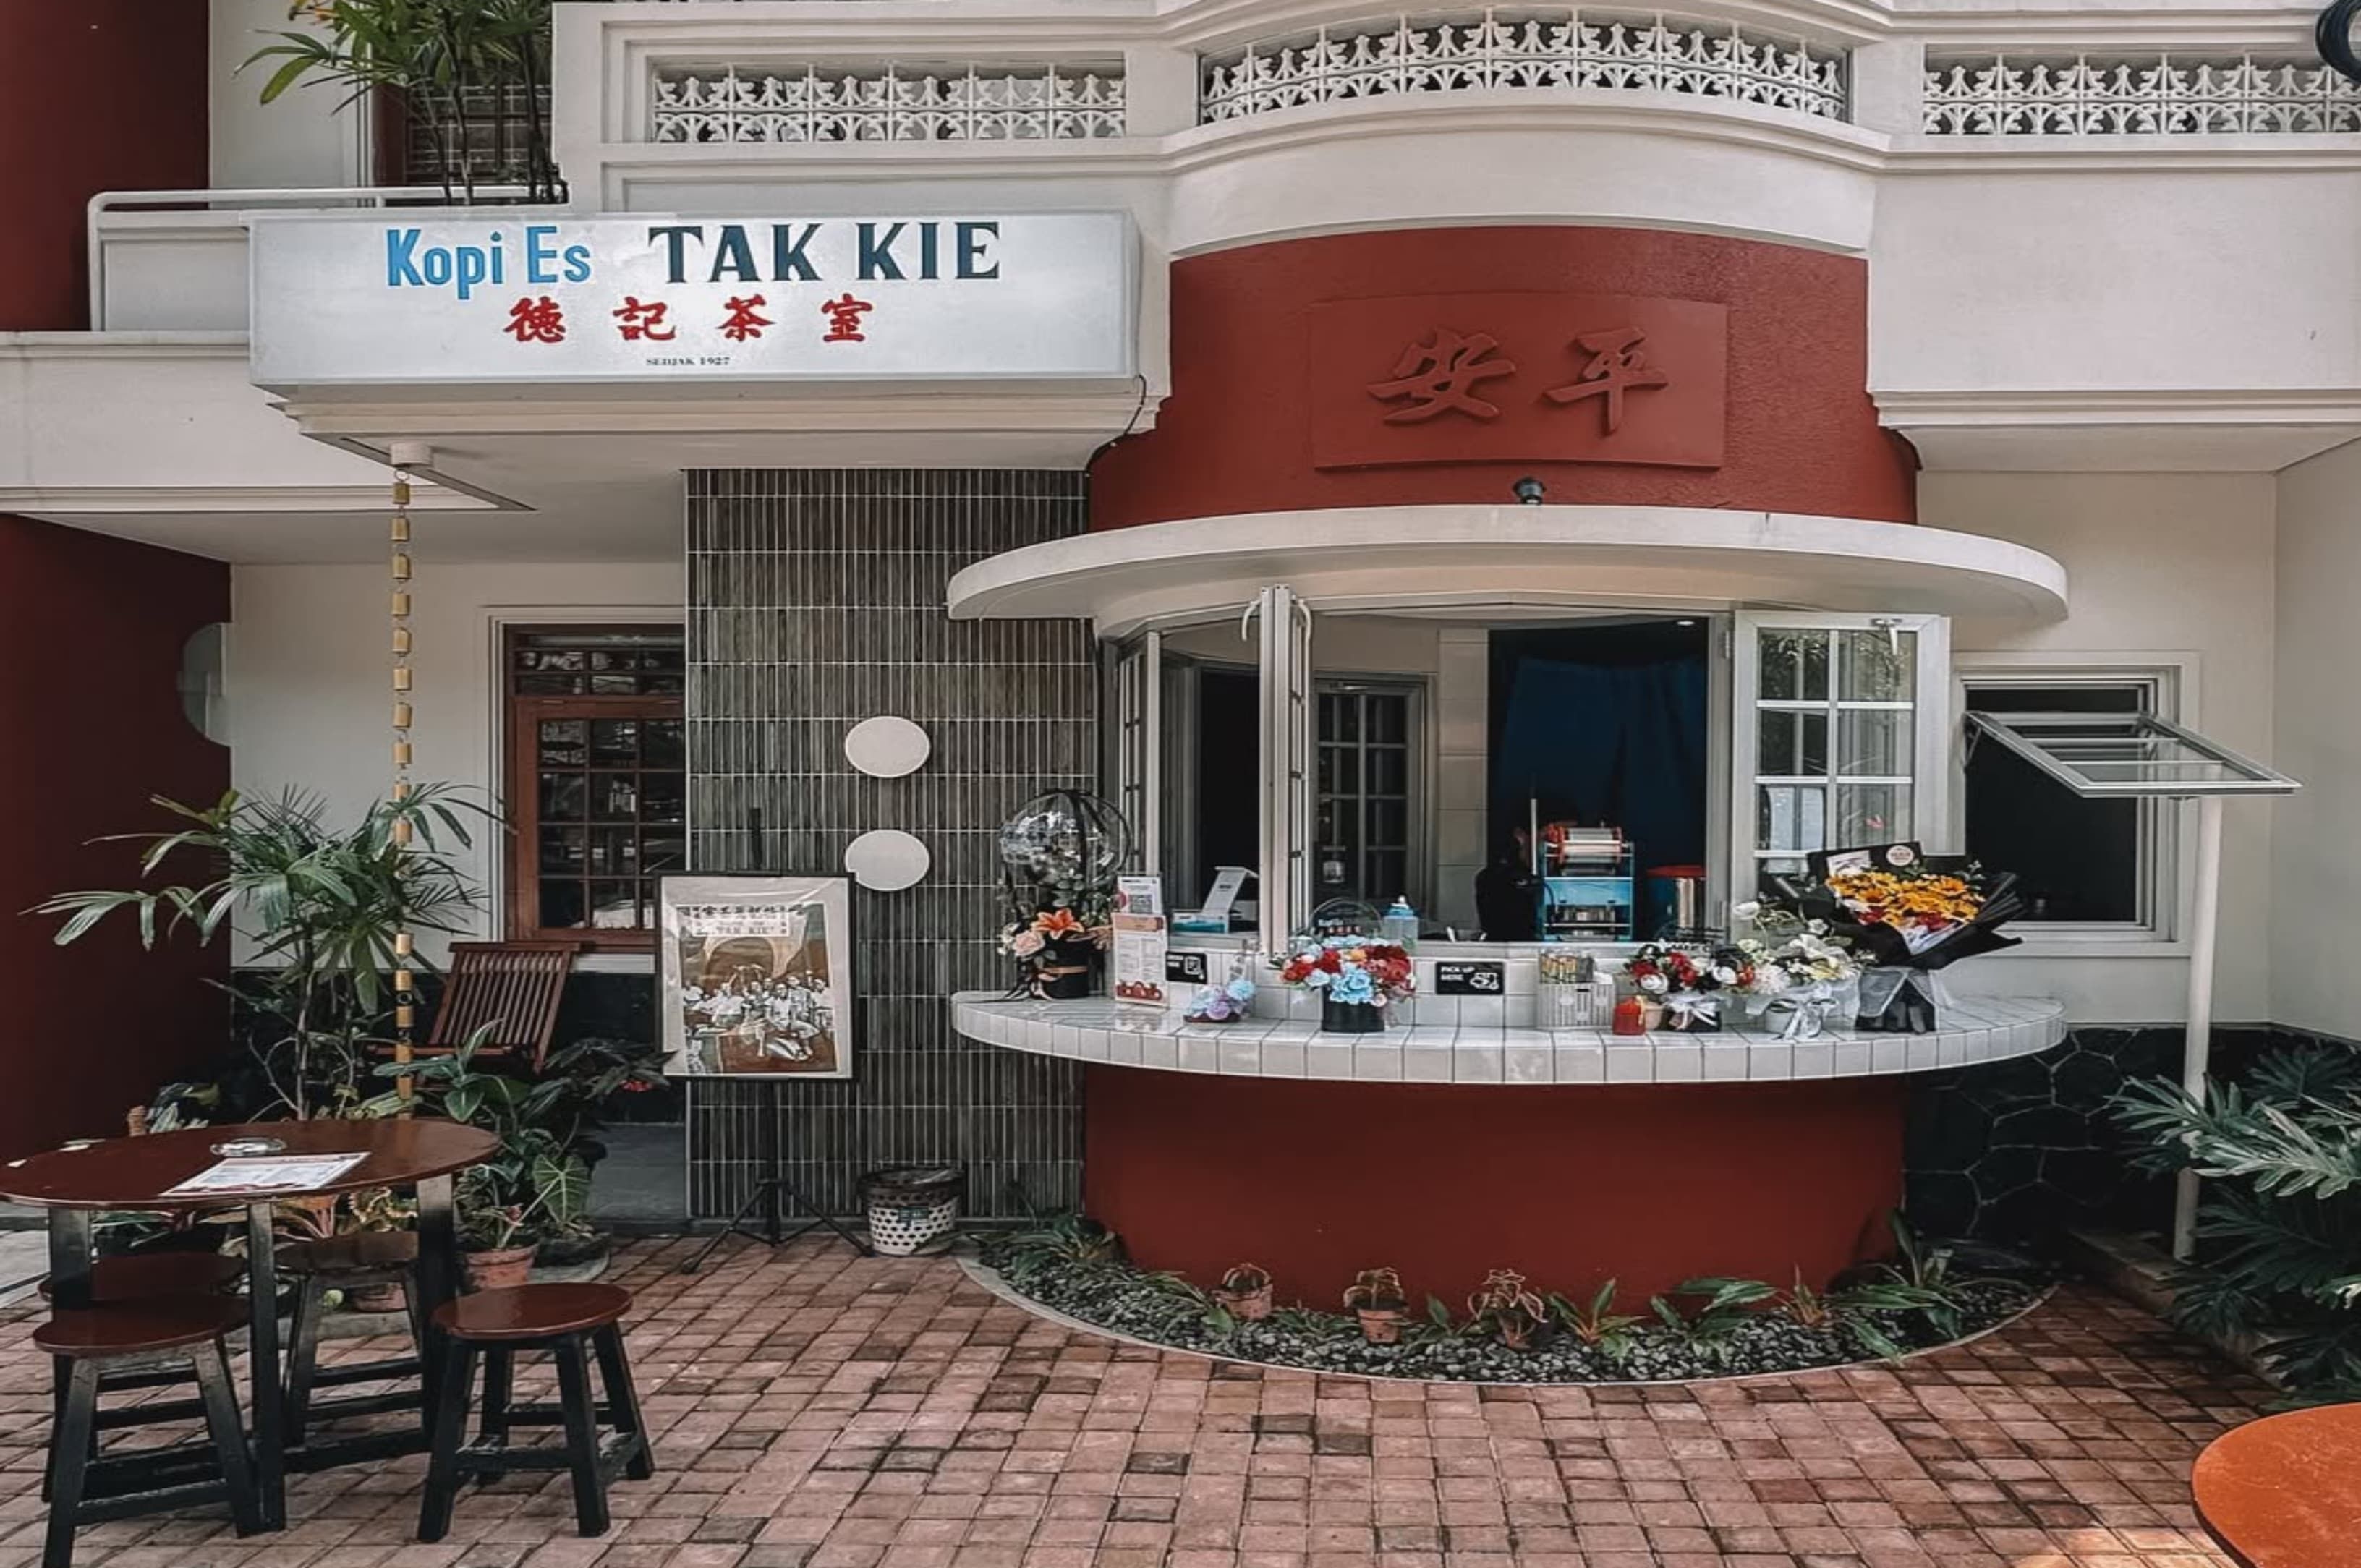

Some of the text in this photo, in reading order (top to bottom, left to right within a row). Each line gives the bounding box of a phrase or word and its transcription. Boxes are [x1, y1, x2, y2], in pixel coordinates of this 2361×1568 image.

[387, 221, 999, 300] Kopi Es TAK KIE
[699, 357, 731, 365] 1927
